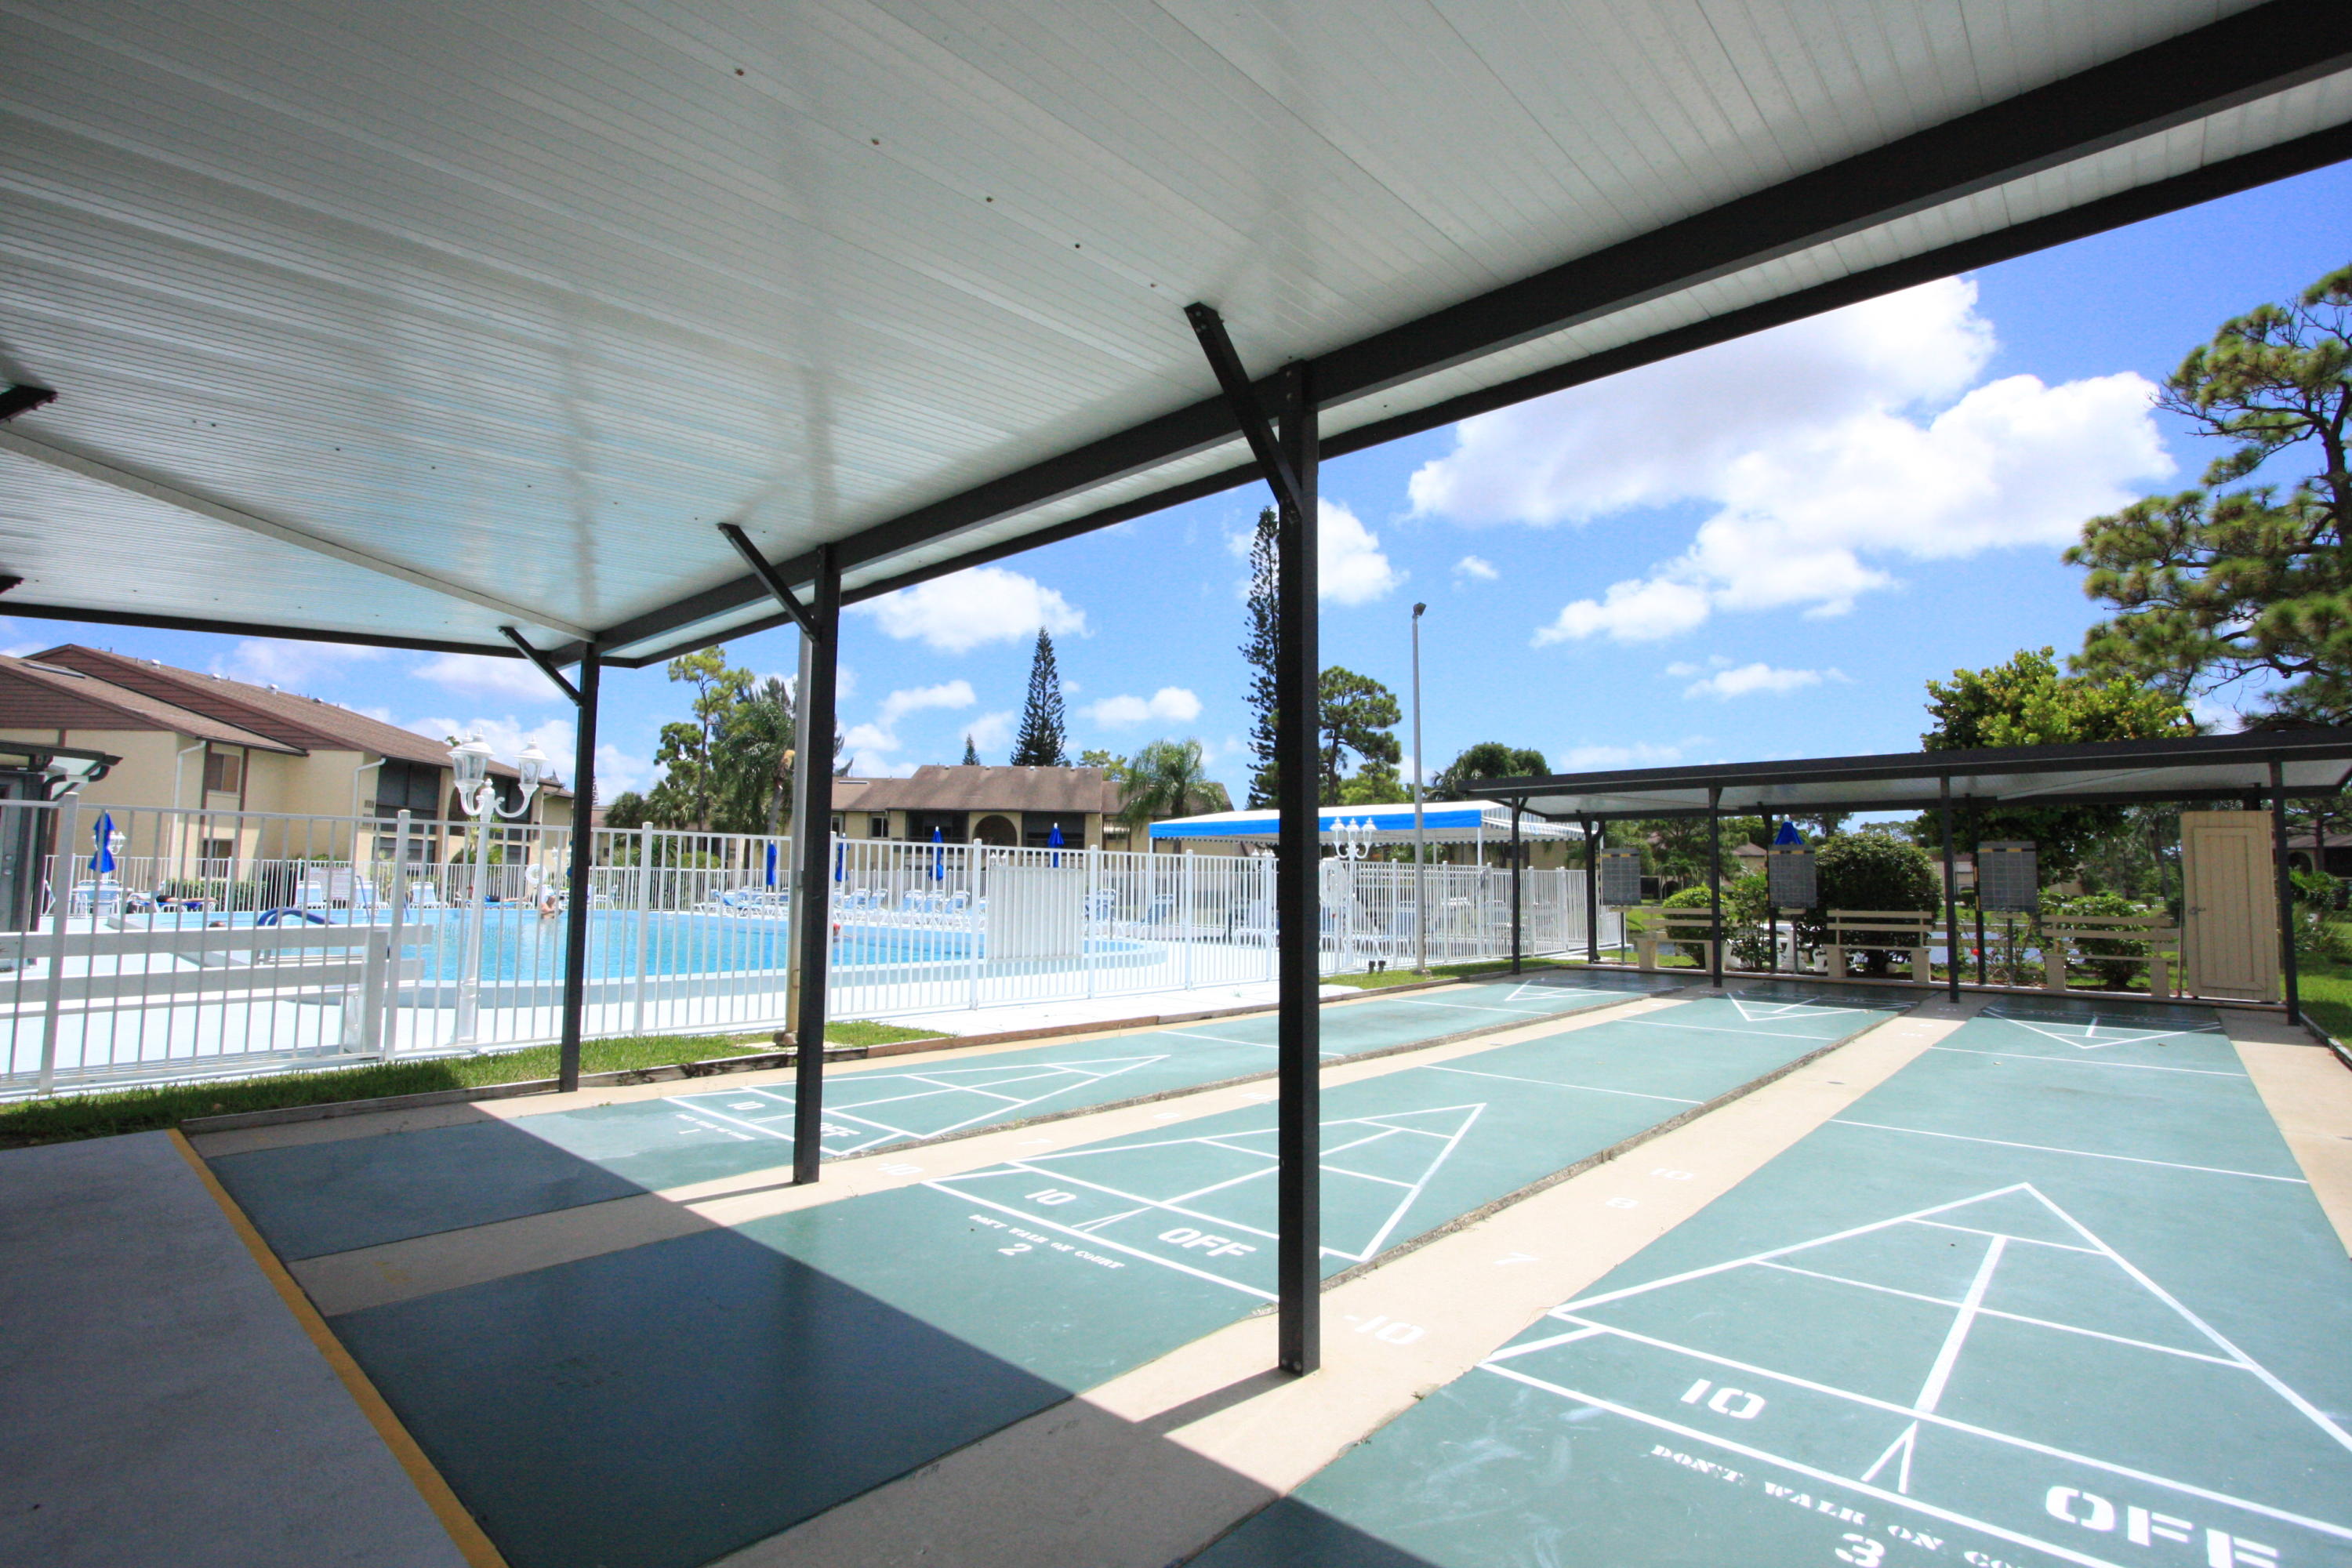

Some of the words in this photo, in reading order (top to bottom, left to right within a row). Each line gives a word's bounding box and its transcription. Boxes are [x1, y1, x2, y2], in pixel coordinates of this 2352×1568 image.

[728, 1101, 766, 1110] 10
[1649, 1168, 1694, 1181] 10
[1024, 1189, 1077, 1205] 10
[997, 1243, 1033, 1256] 2
[1051, 1242, 1075, 1252] ON
[1074, 1250, 1126, 1269] COURT
[1157, 1227, 1257, 1257] OFF
[1680, 1378, 1768, 1420] 10
[1764, 1480, 1867, 1526] WALK
[1887, 1525, 1944, 1551] ON
[2045, 1486, 2279, 1568] OFF
[1835, 1533, 1886, 1568] 3
